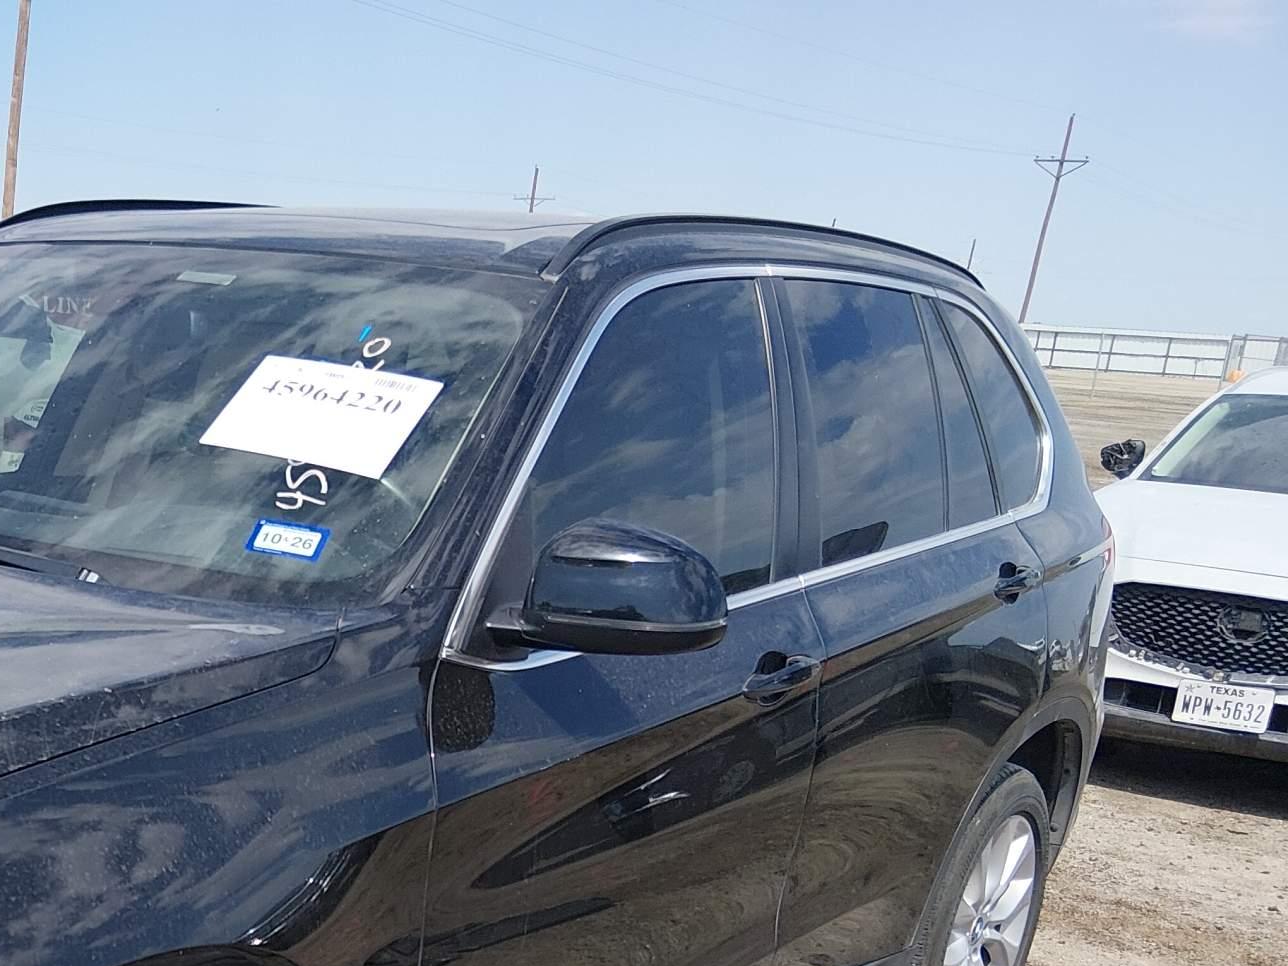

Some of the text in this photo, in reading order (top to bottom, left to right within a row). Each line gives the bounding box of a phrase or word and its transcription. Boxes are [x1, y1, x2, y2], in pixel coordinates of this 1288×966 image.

[262, 379, 402, 414] 45964220
[1210, 686, 1246, 697] TEXAS
[1222, 700, 1266, 723] 5632
